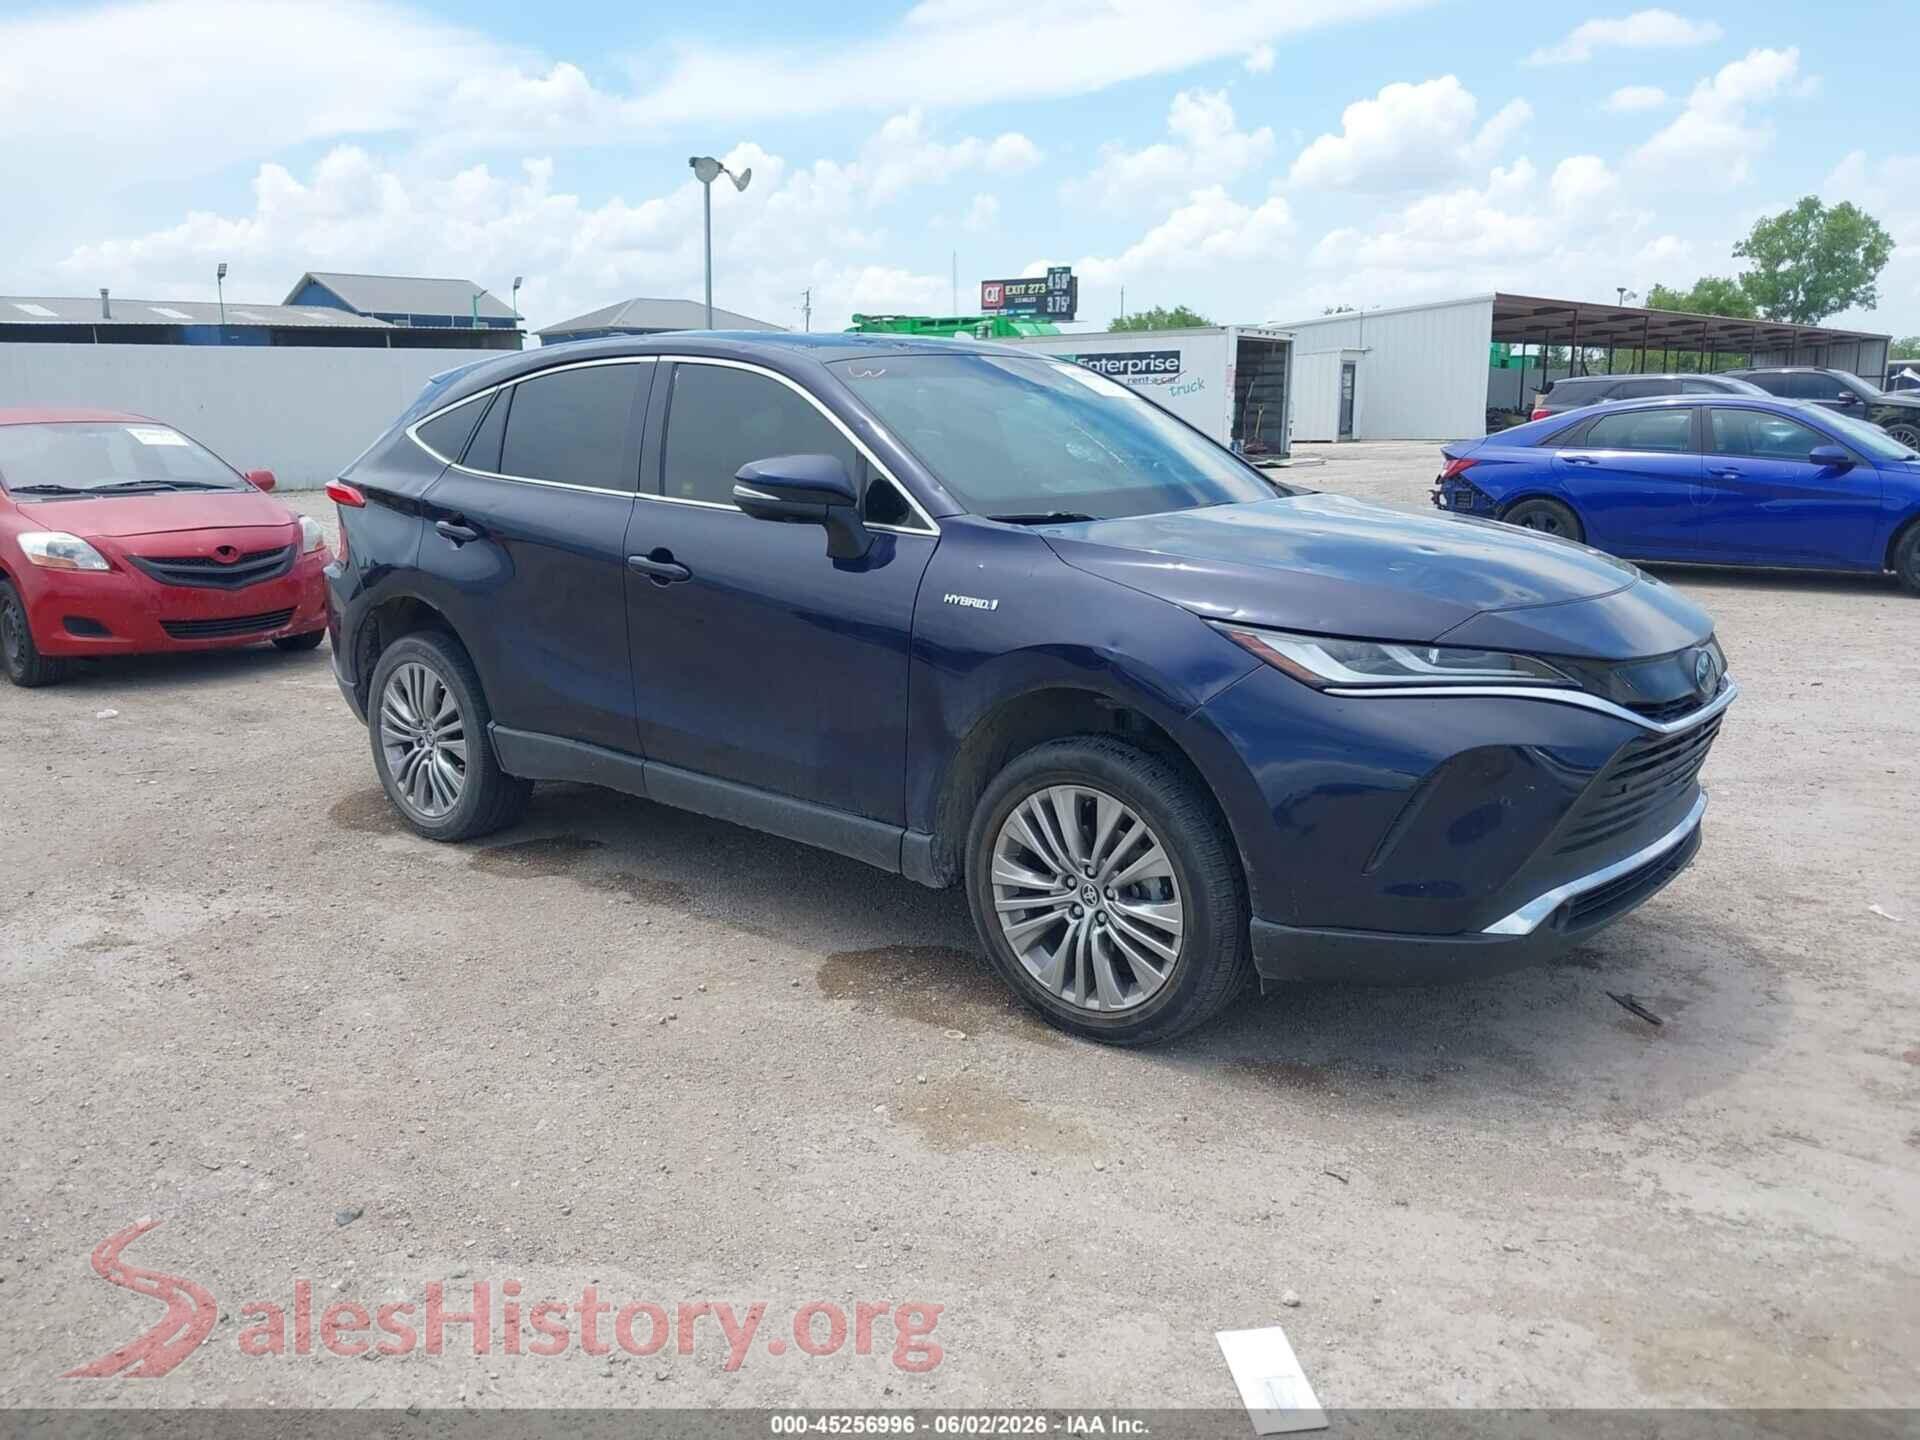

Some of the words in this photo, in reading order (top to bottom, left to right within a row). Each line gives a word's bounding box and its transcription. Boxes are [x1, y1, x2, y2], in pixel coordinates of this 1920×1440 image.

[984, 286, 1001, 304] QT
[1005, 285, 1026, 296] EXIT
[1028, 283, 1046, 294] 273
[1169, 377, 1206, 397] truck
[943, 593, 989, 609] HYBRID
